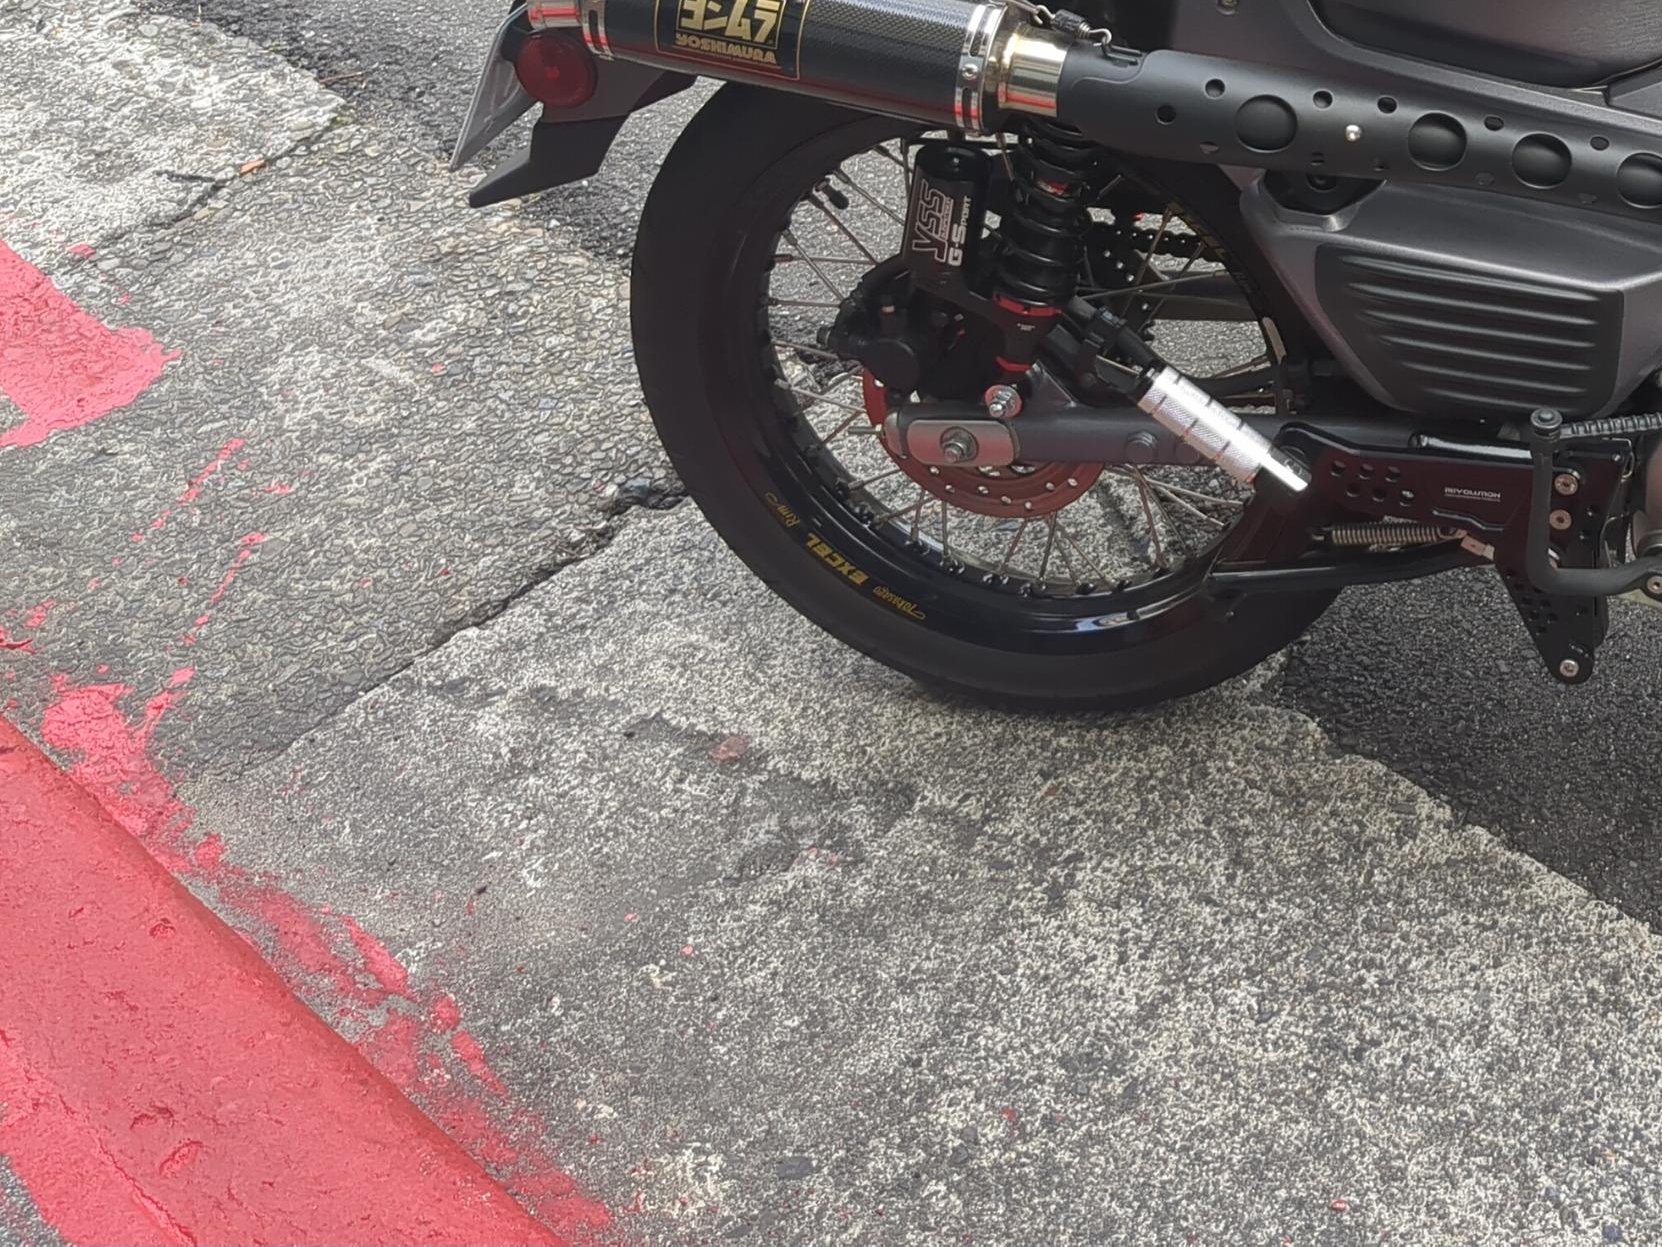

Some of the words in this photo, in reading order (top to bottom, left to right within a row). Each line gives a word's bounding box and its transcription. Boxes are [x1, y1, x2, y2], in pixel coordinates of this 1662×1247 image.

[675, 32, 778, 65] YOSHIMURA
[912, 178, 948, 263] YSS
[804, 533, 869, 587] EXCEL
